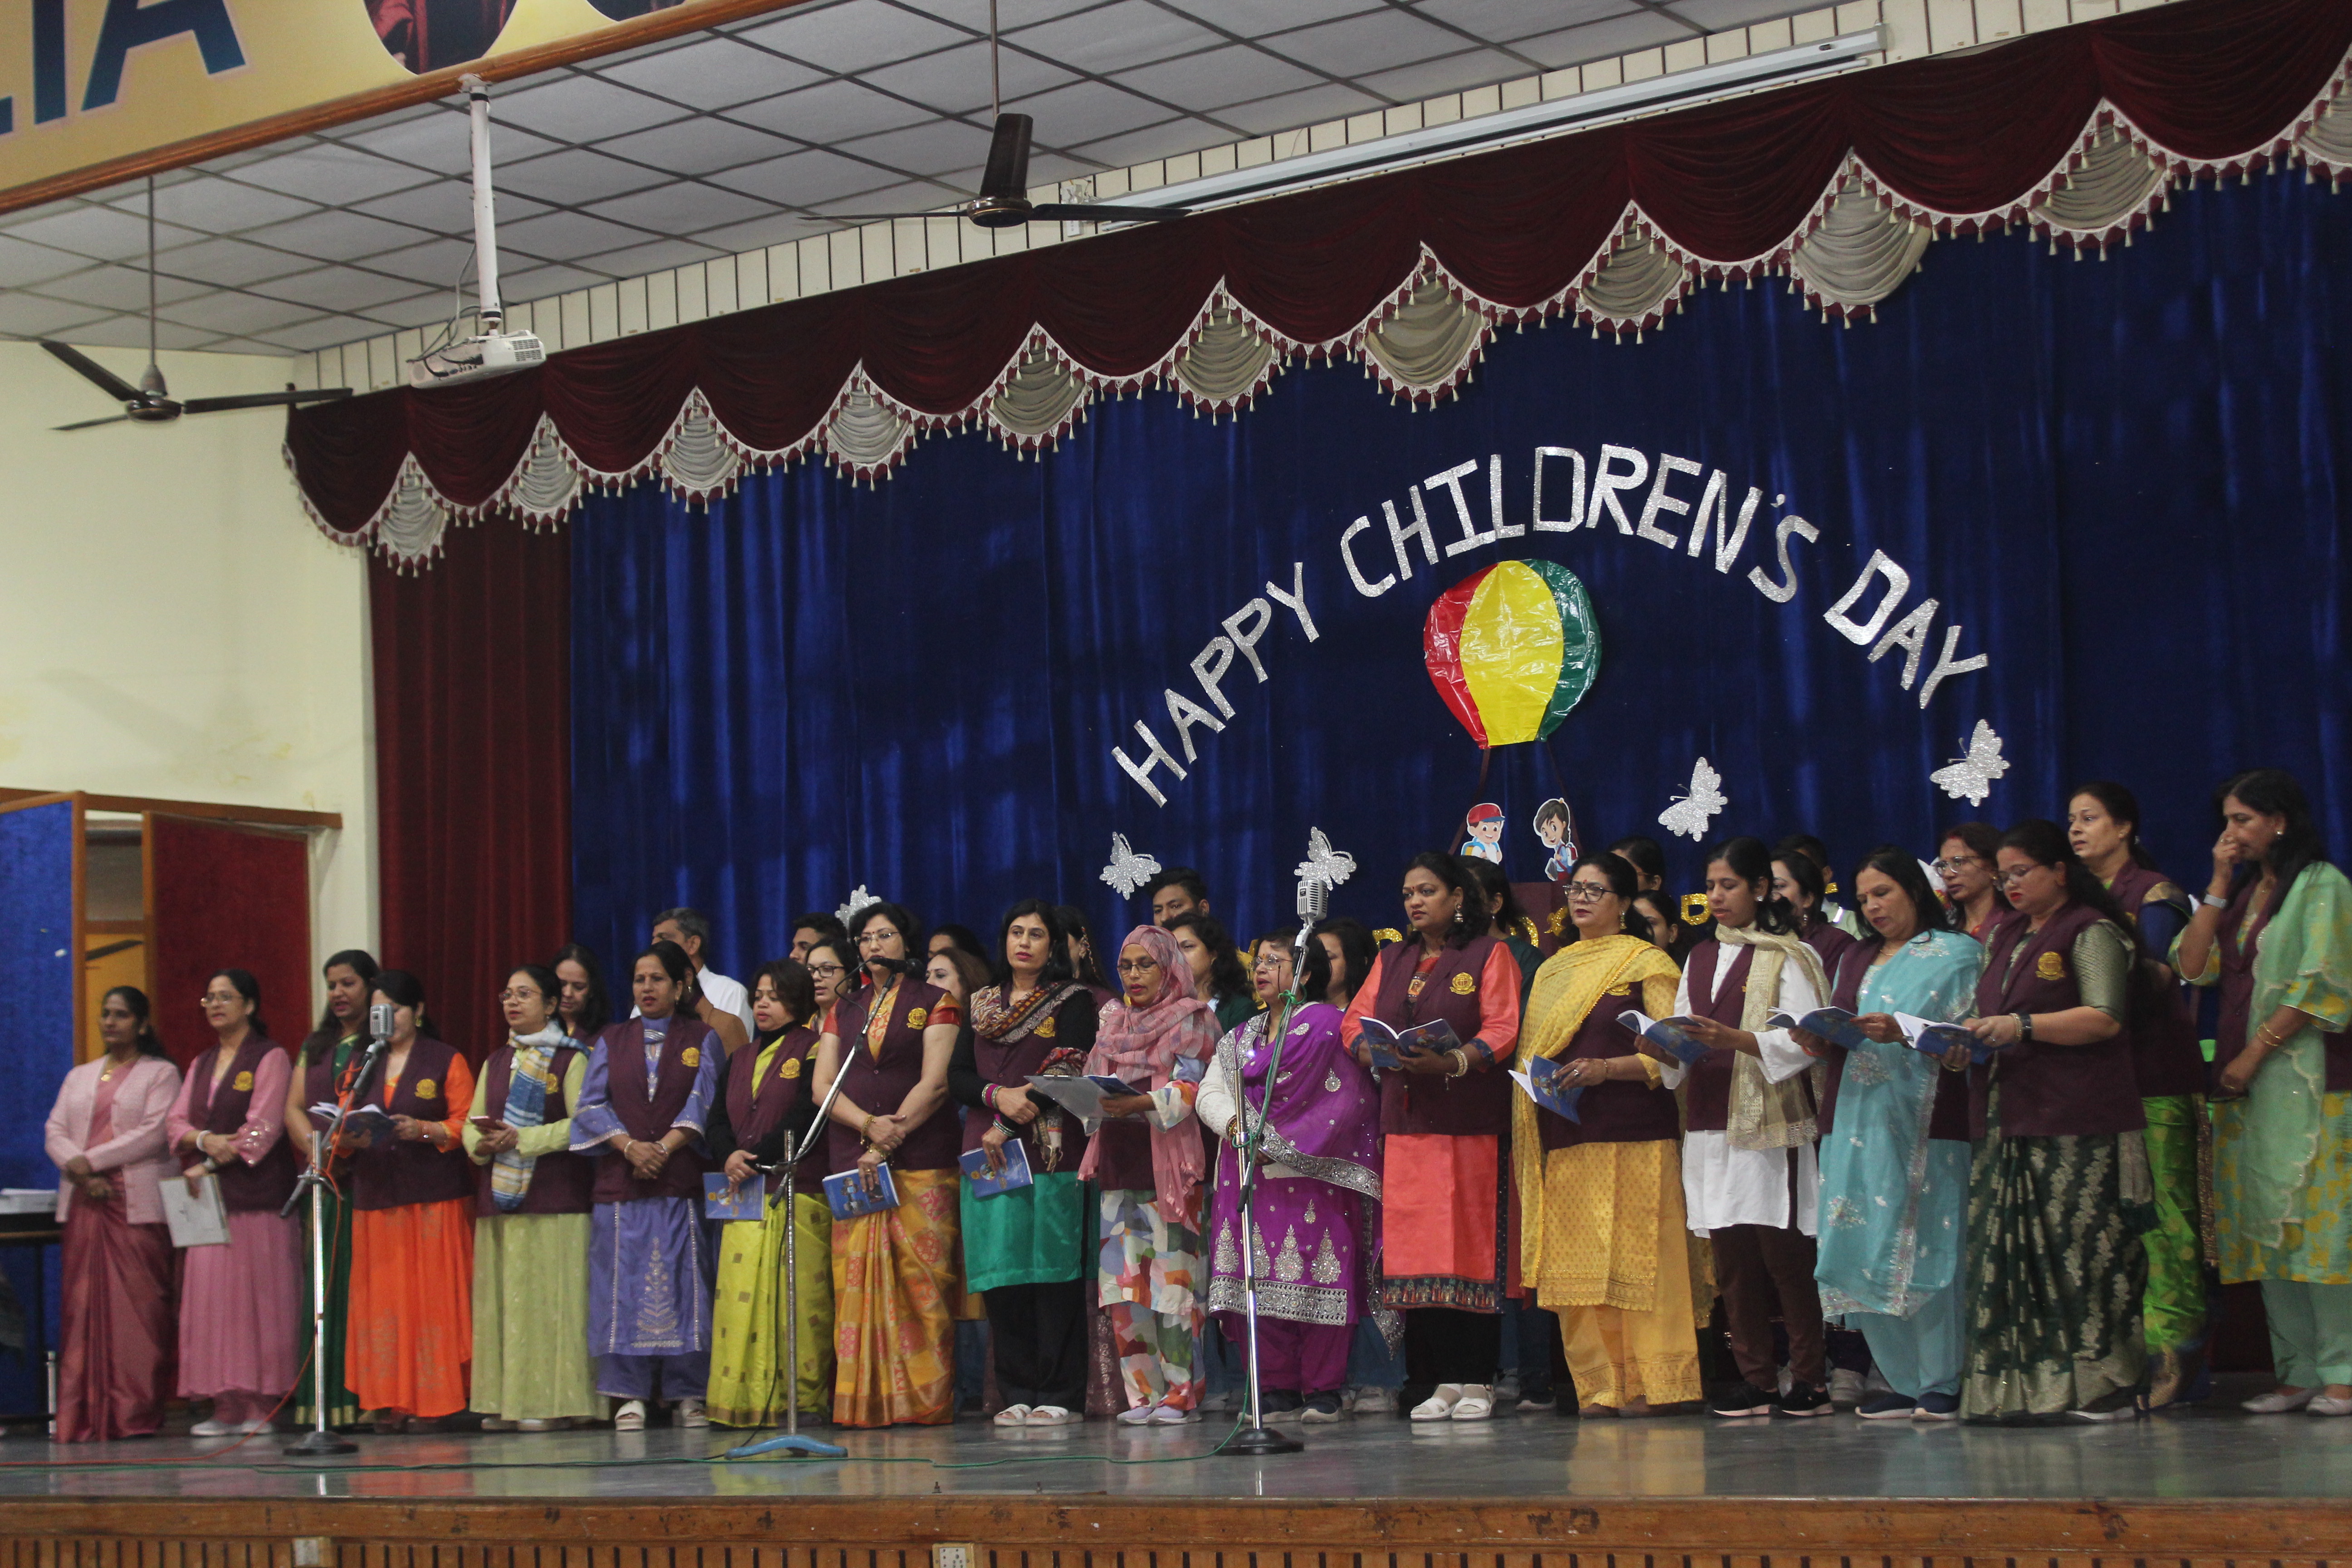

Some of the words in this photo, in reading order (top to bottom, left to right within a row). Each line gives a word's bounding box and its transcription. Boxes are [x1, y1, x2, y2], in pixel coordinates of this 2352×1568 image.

[1111, 562, 1319, 808] HAPPY
[1340, 444, 1820, 603] CHILDREN'S
[1823, 549, 1989, 709] DAY
